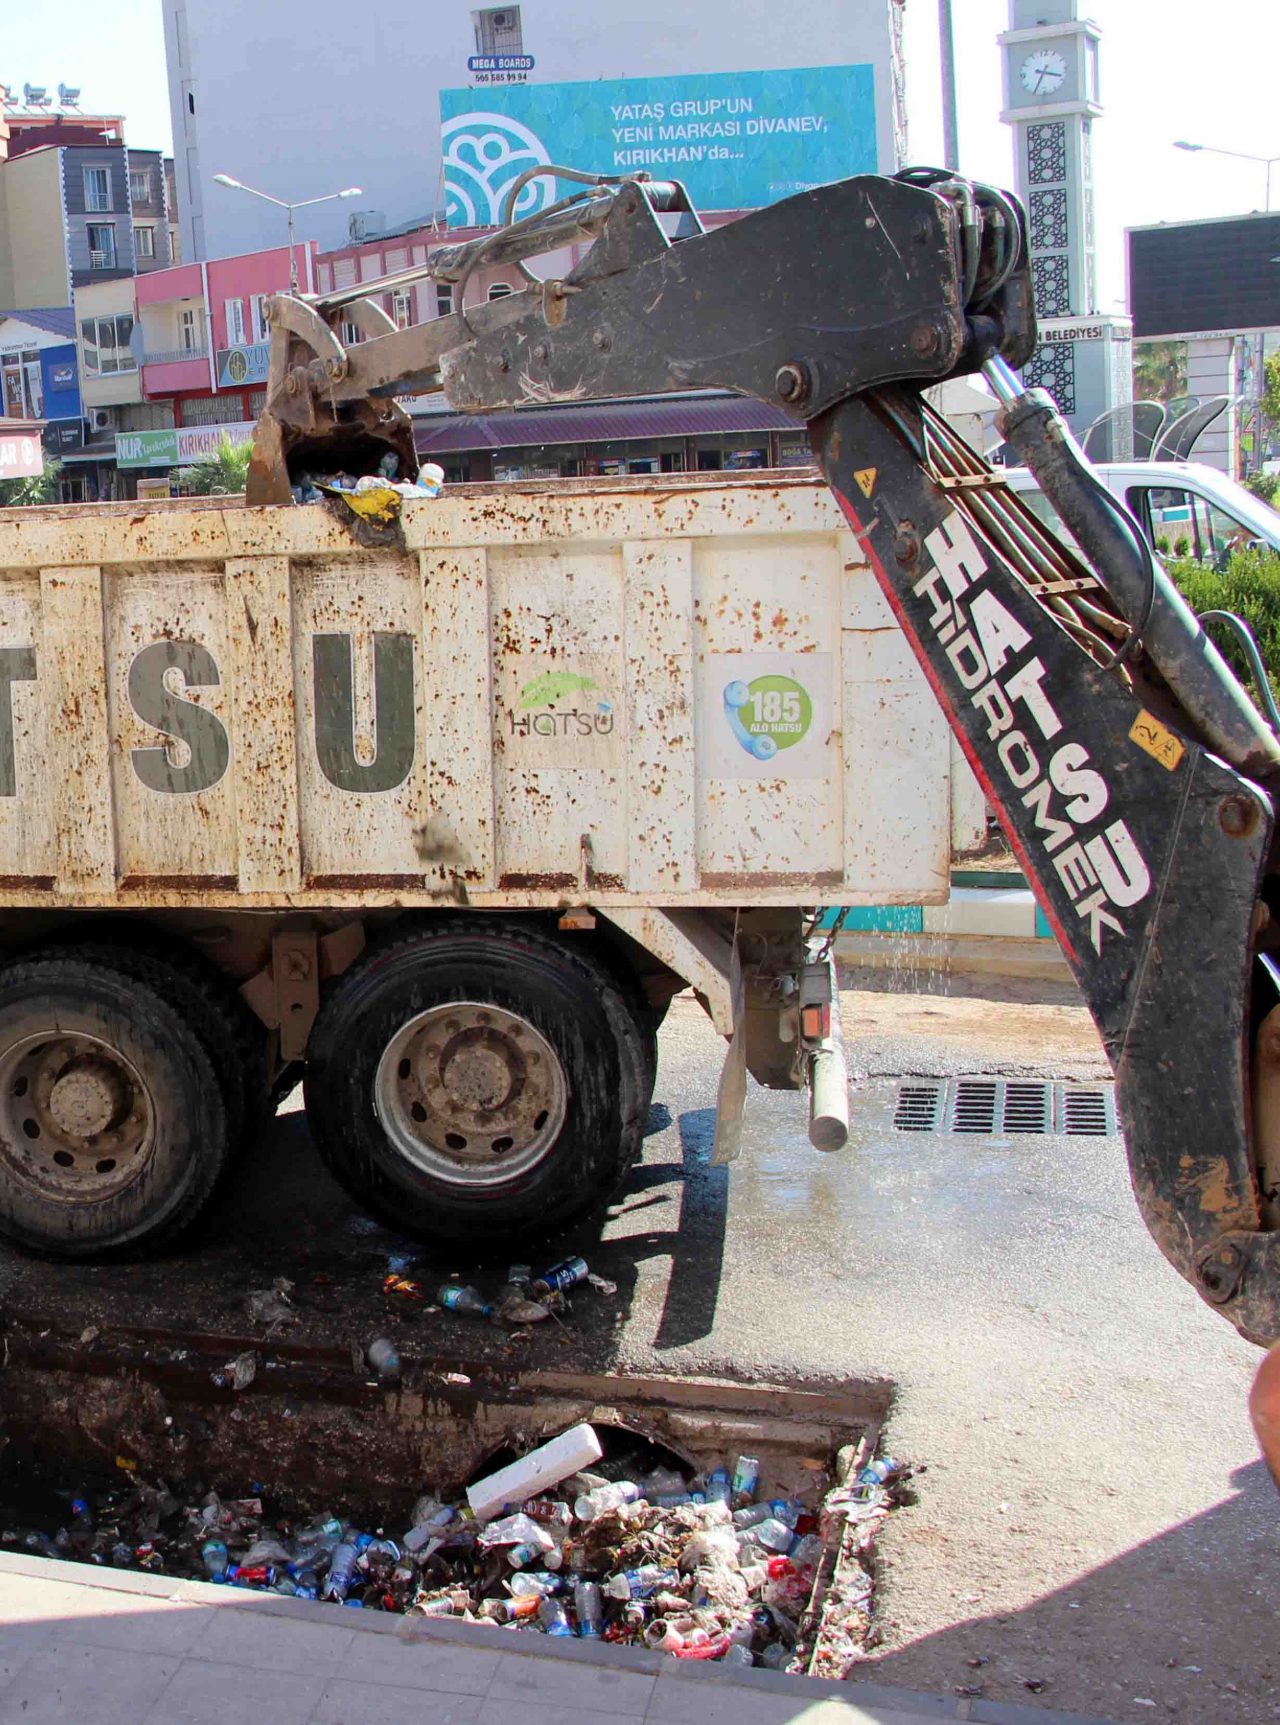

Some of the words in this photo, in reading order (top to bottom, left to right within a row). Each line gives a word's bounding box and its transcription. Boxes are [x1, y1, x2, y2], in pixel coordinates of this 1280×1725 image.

[472, 59, 496, 69] MEGA
[499, 58, 531, 69] BOARDS
[611, 103, 665, 124] YATAŞ
[670, 97, 753, 118] GRUP'UN
[612, 126, 654, 144] YENİ
[659, 120, 741, 141] MARKASI
[746, 115, 828, 136] DİVANEV,
[1045, 326, 1102, 341] BELEDİYESİ
[118, 437, 142, 459] NUR
[750, 690, 801, 722] 185
[923, 510, 1151, 908] HATSU
[750, 723, 770, 734] ALO
